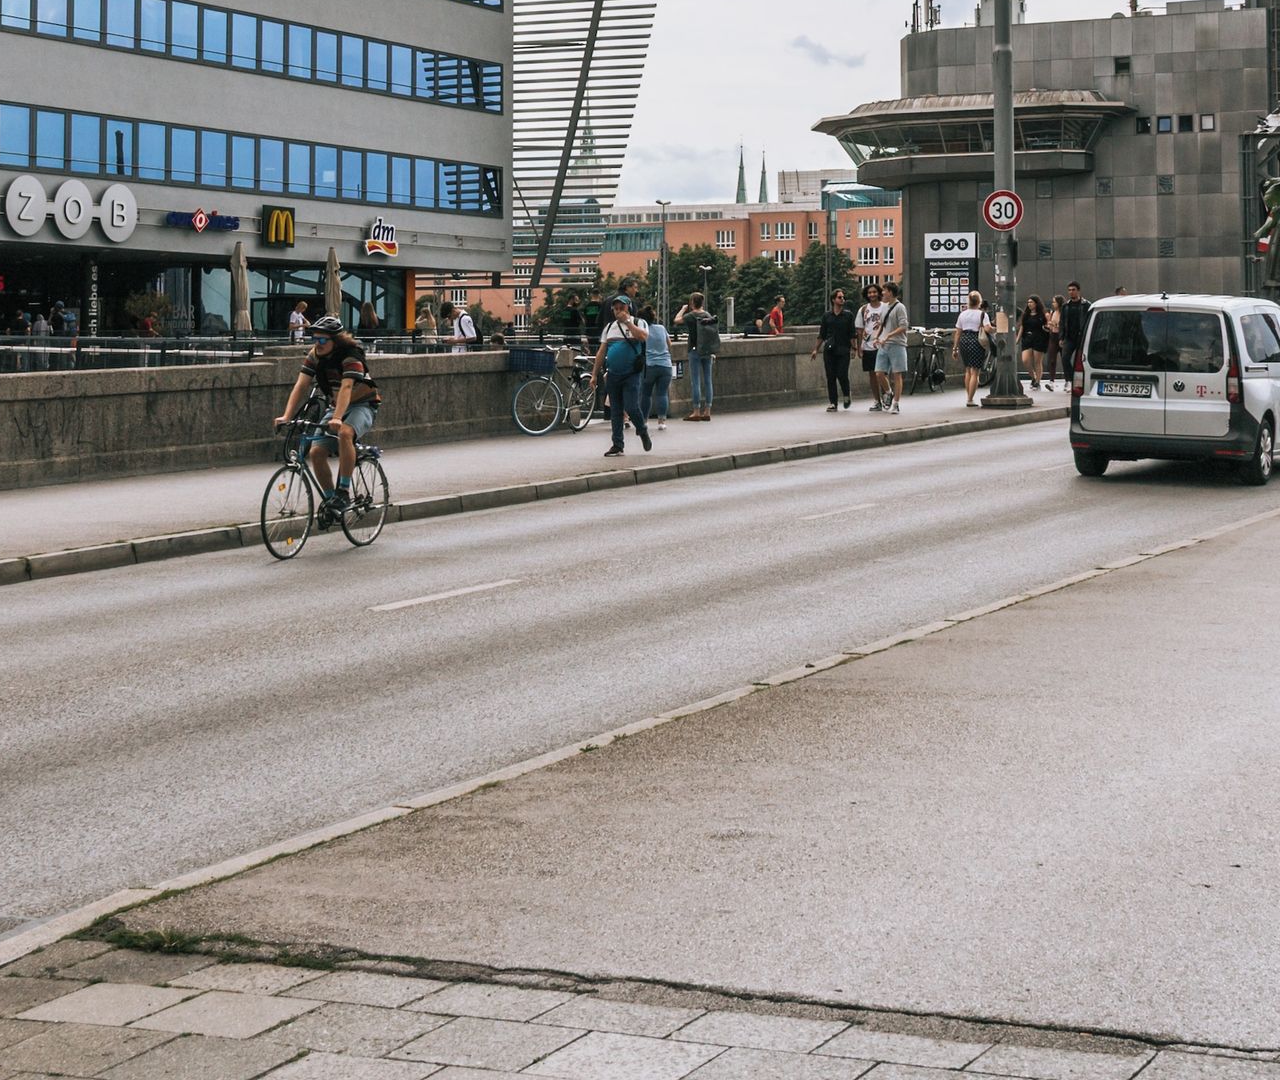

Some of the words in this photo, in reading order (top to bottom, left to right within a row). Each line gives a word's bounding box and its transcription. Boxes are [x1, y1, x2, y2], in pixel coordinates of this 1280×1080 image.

[992, 201, 1015, 220] 30
[372, 218, 395, 242] dm
[91, 265, 98, 281] es
[88, 284, 98, 316] liebe
[1104, 383, 1113, 392] MS
[1119, 384, 1129, 393] MS
[1131, 384, 1150, 394] 9875
